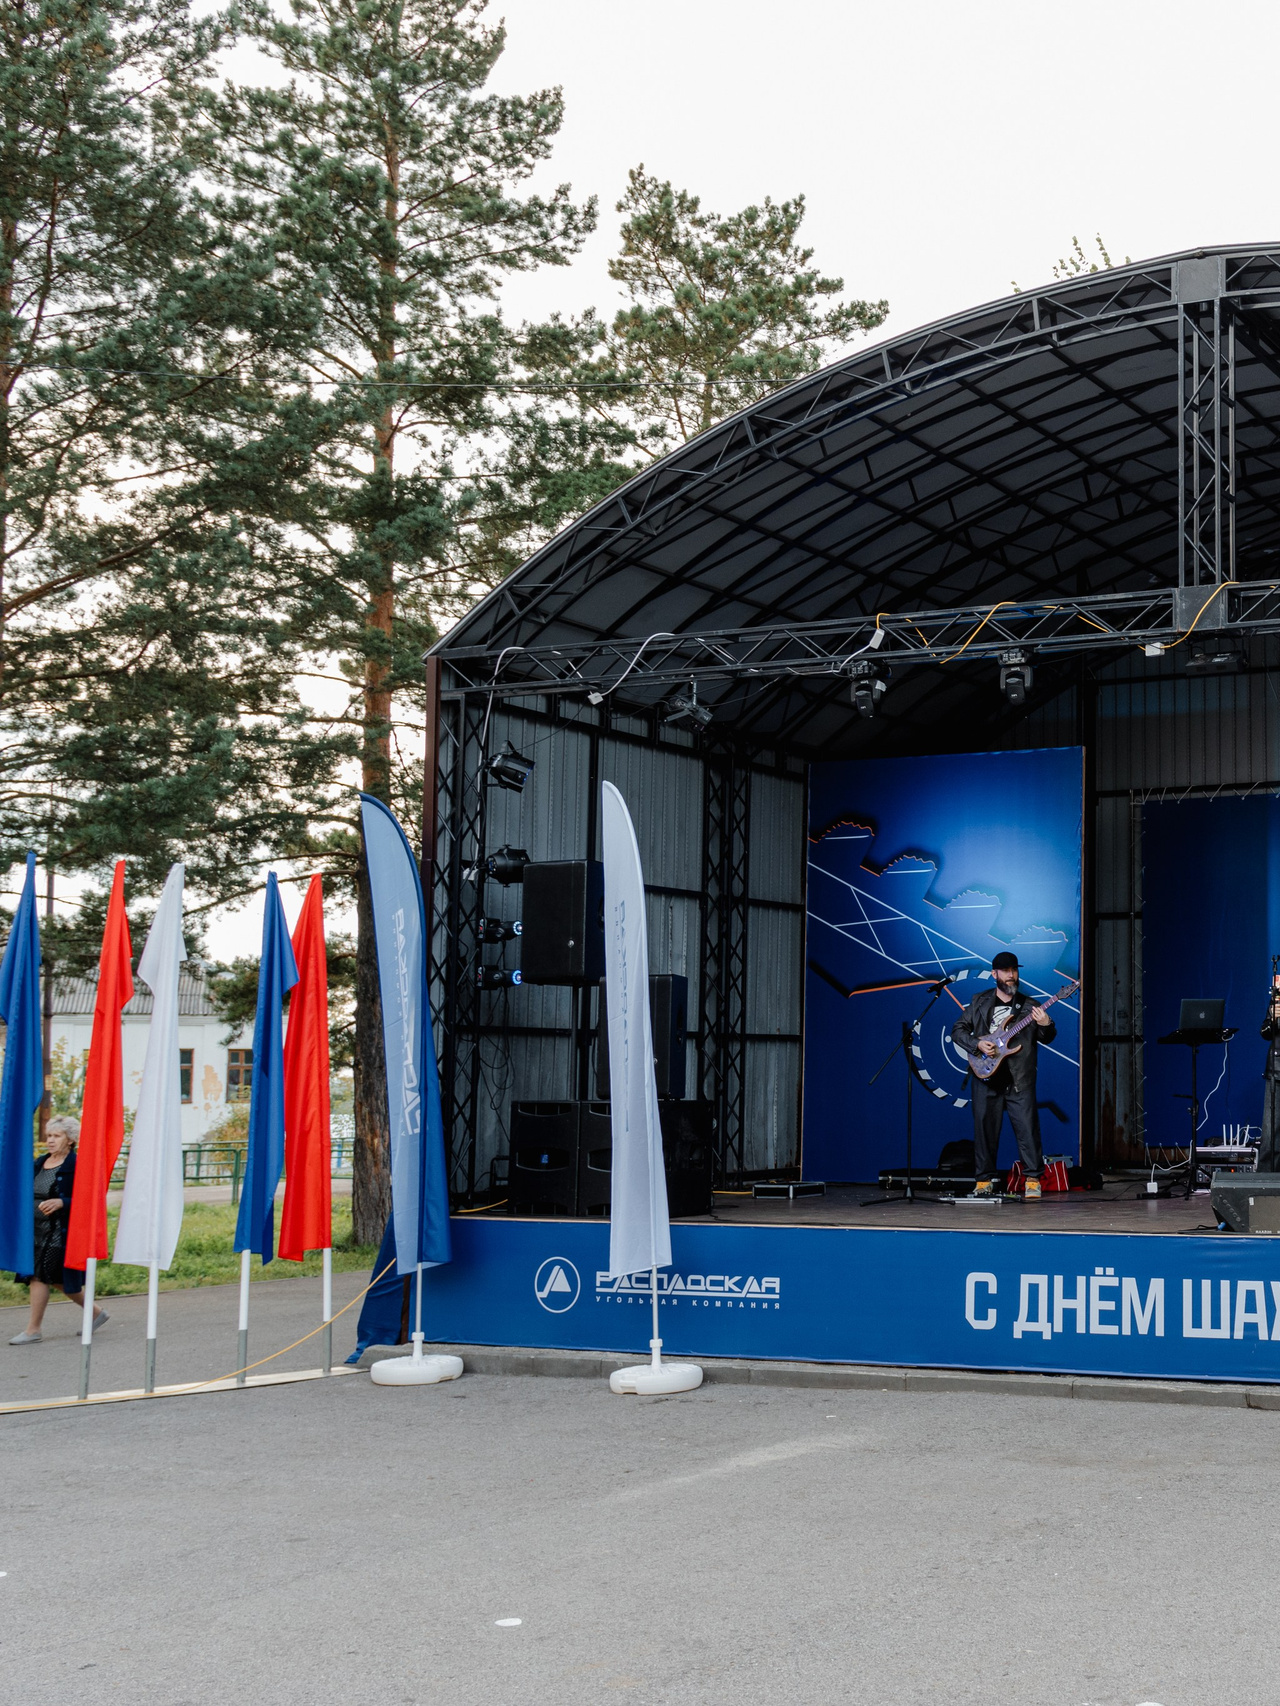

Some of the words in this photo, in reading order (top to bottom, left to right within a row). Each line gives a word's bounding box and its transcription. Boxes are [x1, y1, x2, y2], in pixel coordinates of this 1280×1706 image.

[595, 1271, 780, 1299] РАСПАДСКАЯ
[692, 1299, 780, 1310] КОМПАНИЯ
[965, 1272, 998, 1330] С
[1013, 1267, 1165, 1340] ДНЁМ
